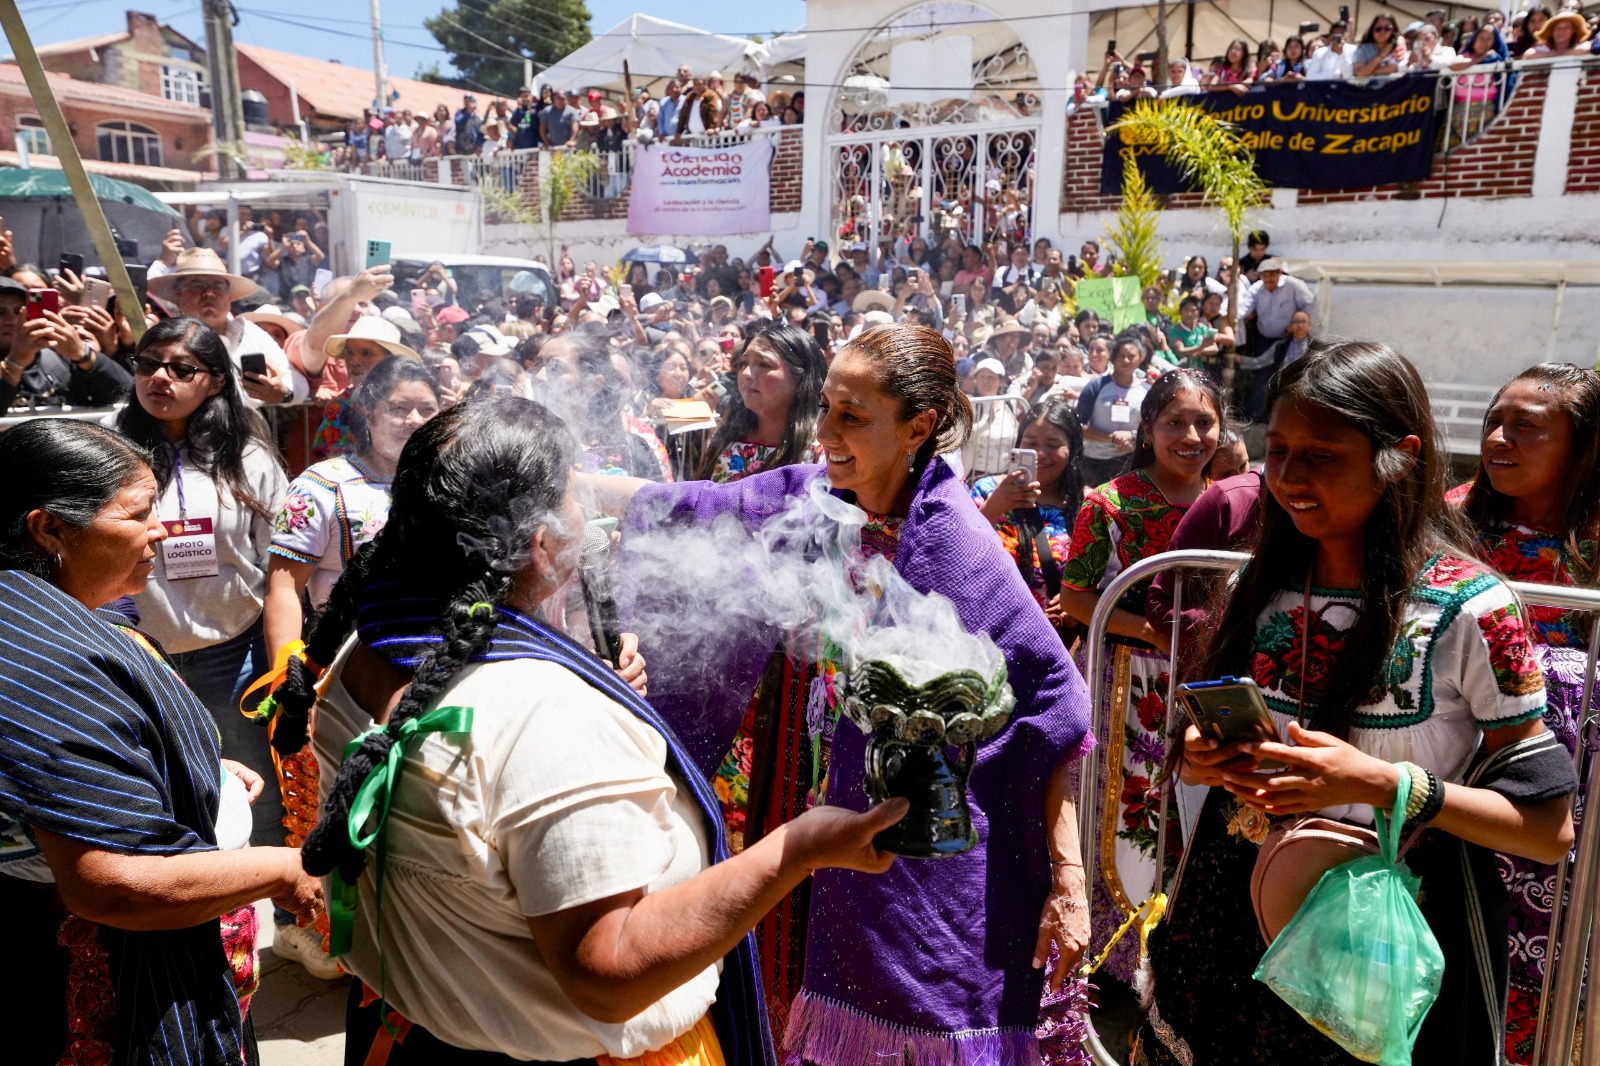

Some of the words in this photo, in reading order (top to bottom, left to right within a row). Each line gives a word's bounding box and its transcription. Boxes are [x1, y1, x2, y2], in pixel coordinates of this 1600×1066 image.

[1192, 104, 1265, 122] entro
[1272, 94, 1430, 123] Universitario
[1288, 132, 1315, 152] de
[1320, 129, 1421, 154] Zacapu
[661, 163, 741, 177] Academia
[677, 177, 741, 185] transformación
[173, 540, 204, 549] APOYO
[167, 548, 212, 559] LOGÍSTICO
